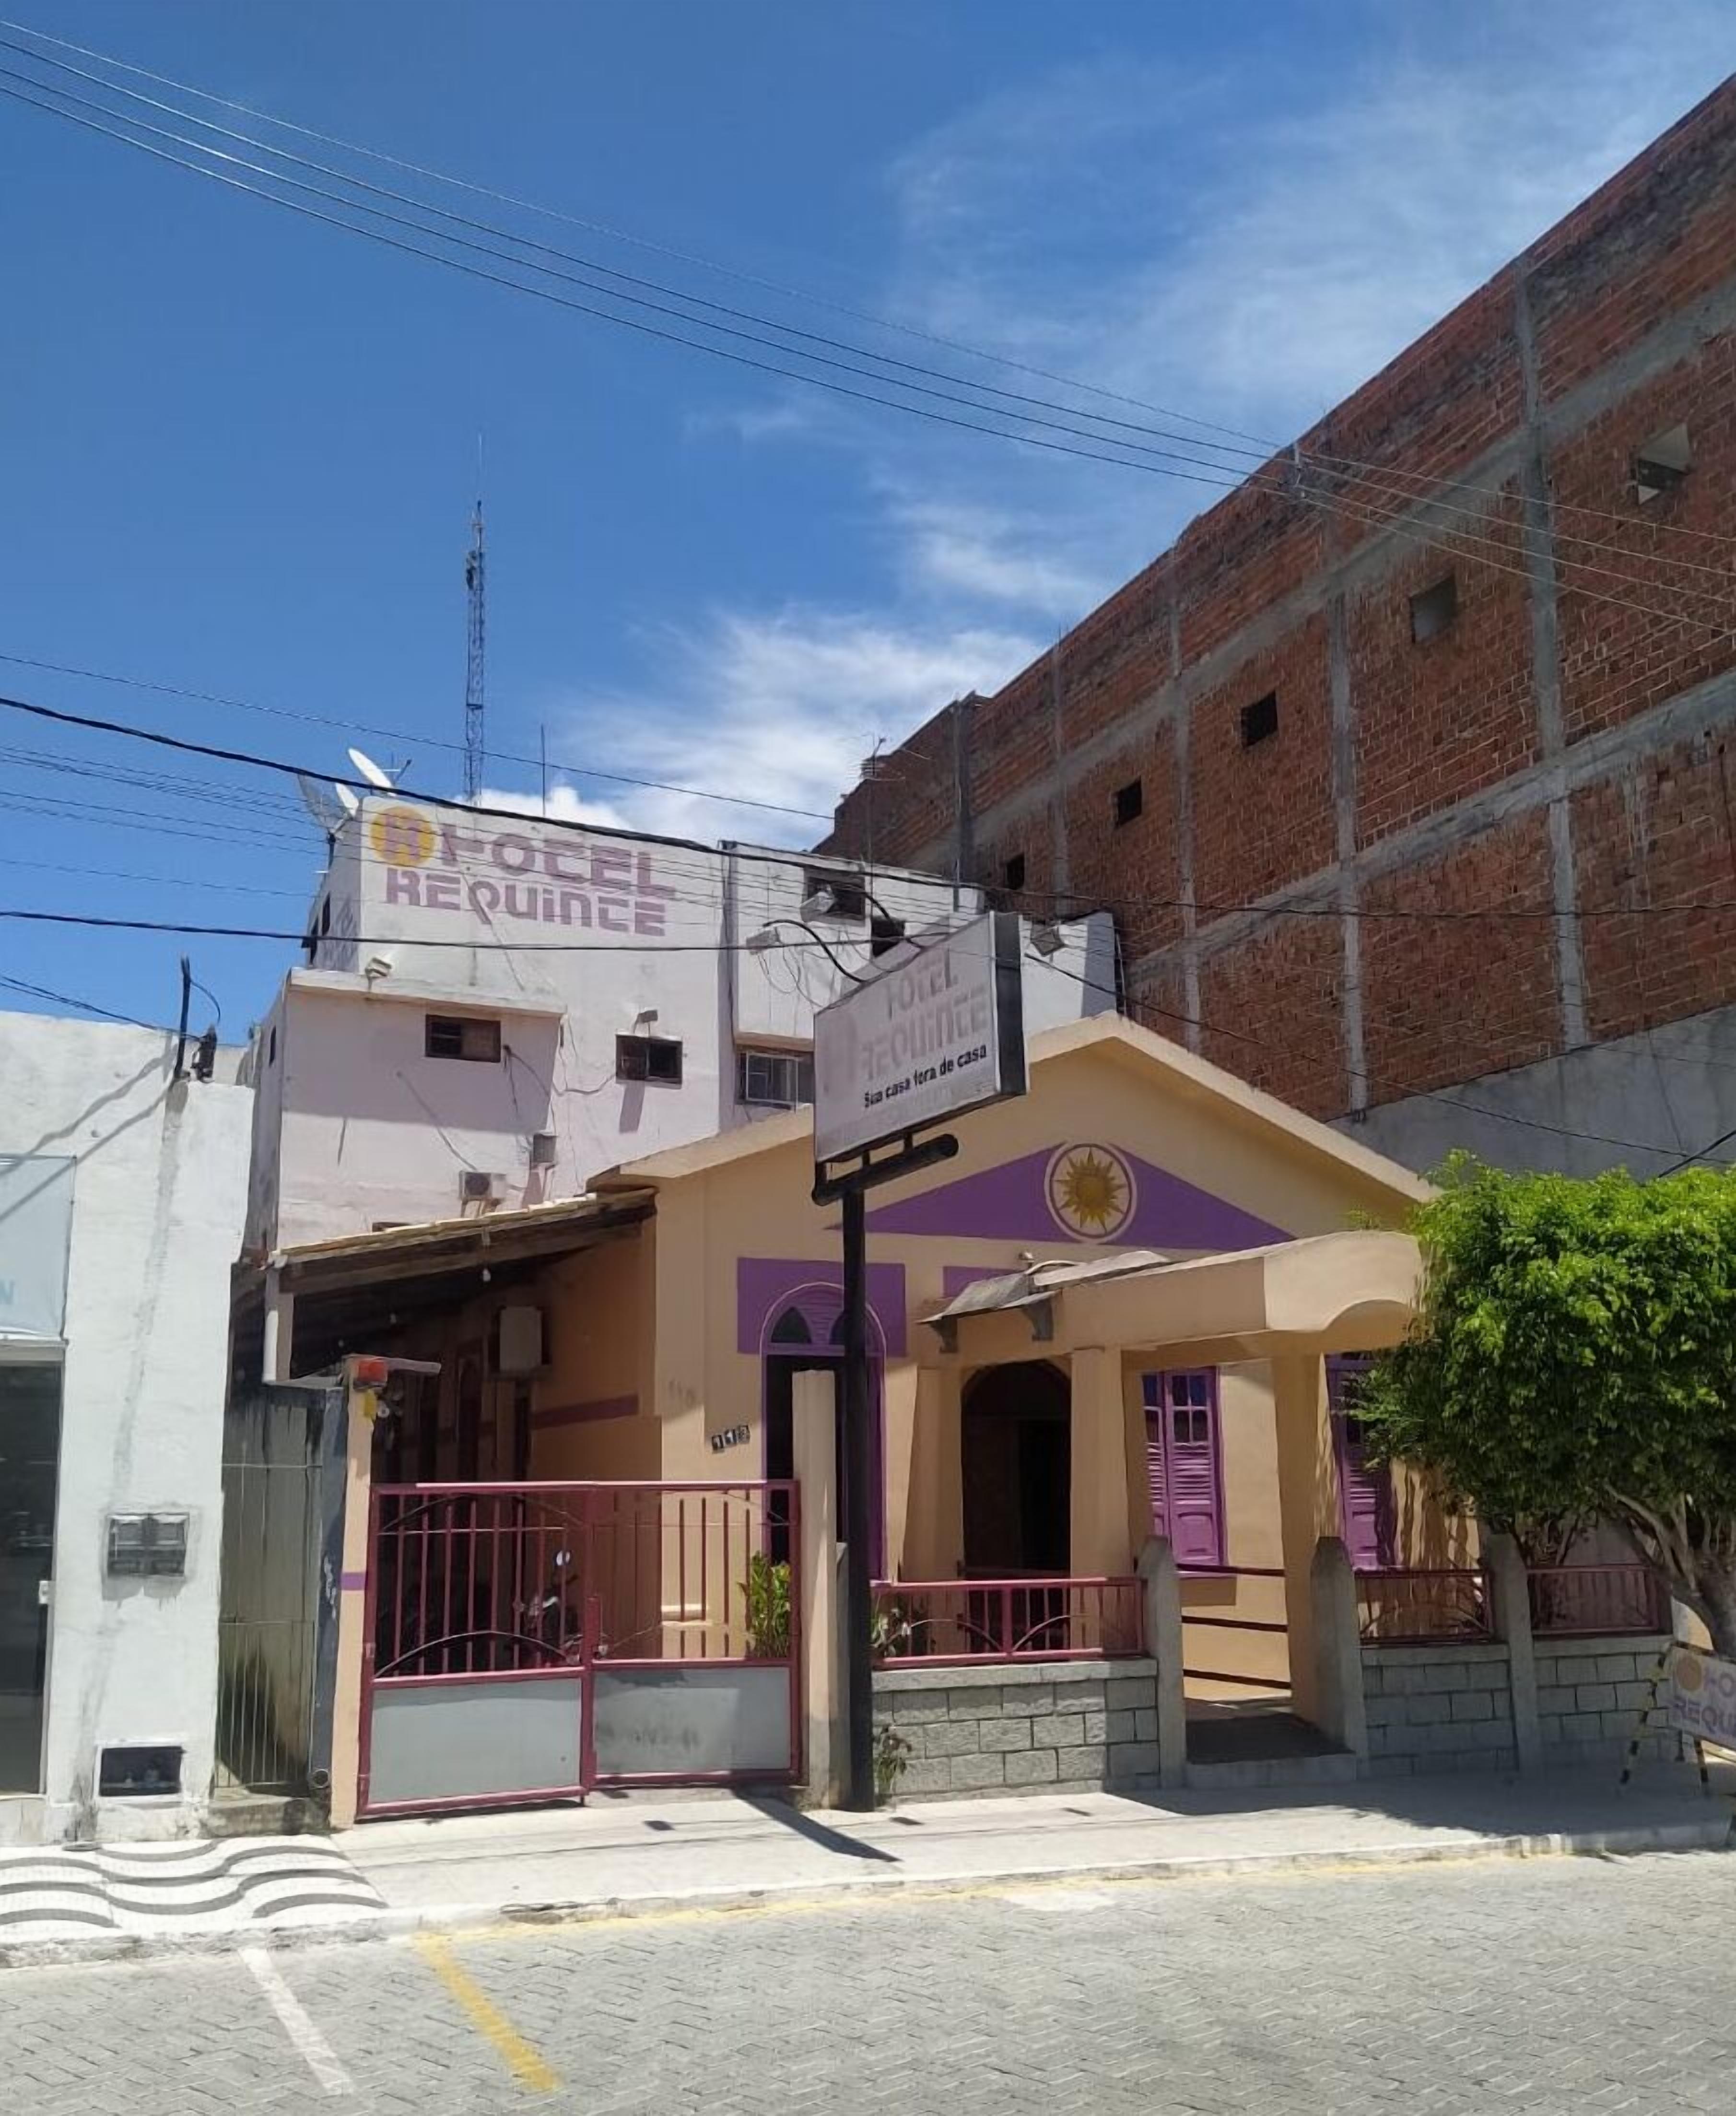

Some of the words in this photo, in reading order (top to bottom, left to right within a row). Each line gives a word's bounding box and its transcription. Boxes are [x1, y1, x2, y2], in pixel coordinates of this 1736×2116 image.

[442, 823, 677, 900] HOTEL
[864, 1090, 883, 1108] Sua
[885, 1078, 911, 1099] casa
[914, 1066, 937, 1087] fora
[939, 1055, 955, 1077] de
[957, 1044, 987, 1068] casa
